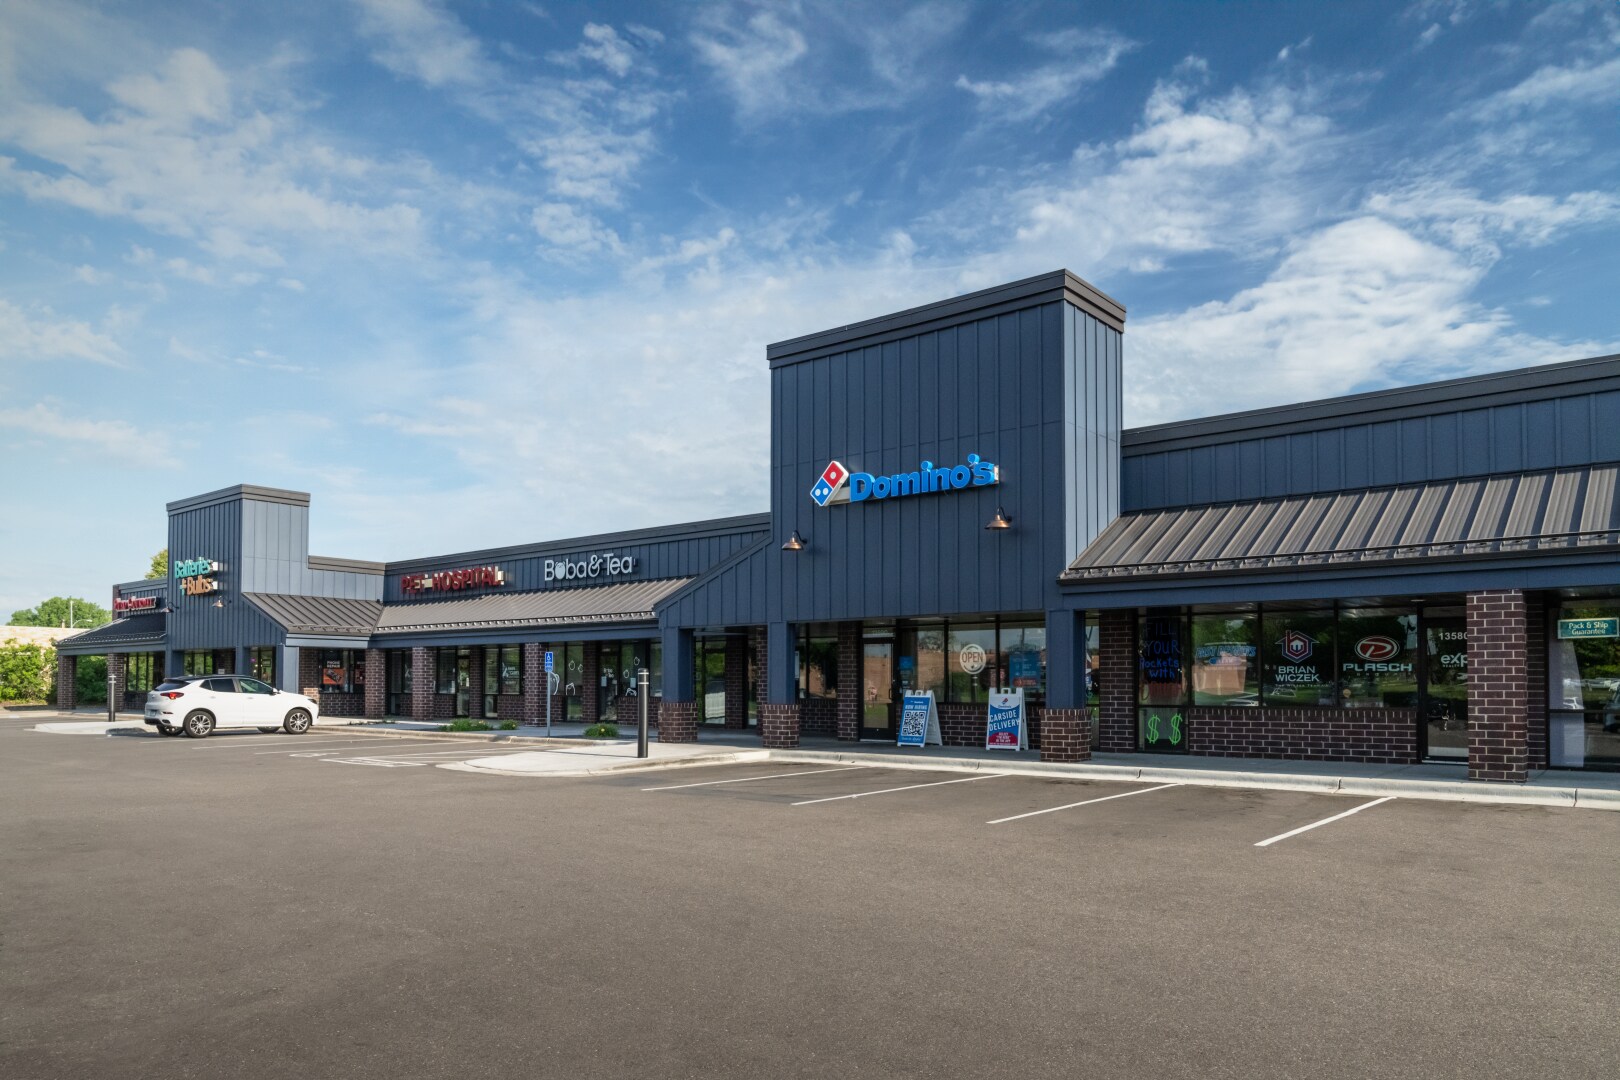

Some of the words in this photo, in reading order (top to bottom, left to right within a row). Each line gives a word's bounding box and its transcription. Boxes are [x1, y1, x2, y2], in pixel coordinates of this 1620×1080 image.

[850, 453, 996, 503] Domino's
[432, 565, 500, 592] HOSPITAL
[1568, 622, 1585, 630] Pack
[1586, 621, 1592, 629] &
[1593, 621, 1609, 629] Ship
[1143, 640, 1181, 658] YOUR
[961, 651, 983, 663] OPEN
[1277, 665, 1316, 674] BRIAN
[1342, 662, 1413, 672] PLASCH
[1275, 673, 1320, 682] WICZEK
[990, 709, 1017, 723] CARSIDE
[989, 718, 1020, 731] DELIVERY
